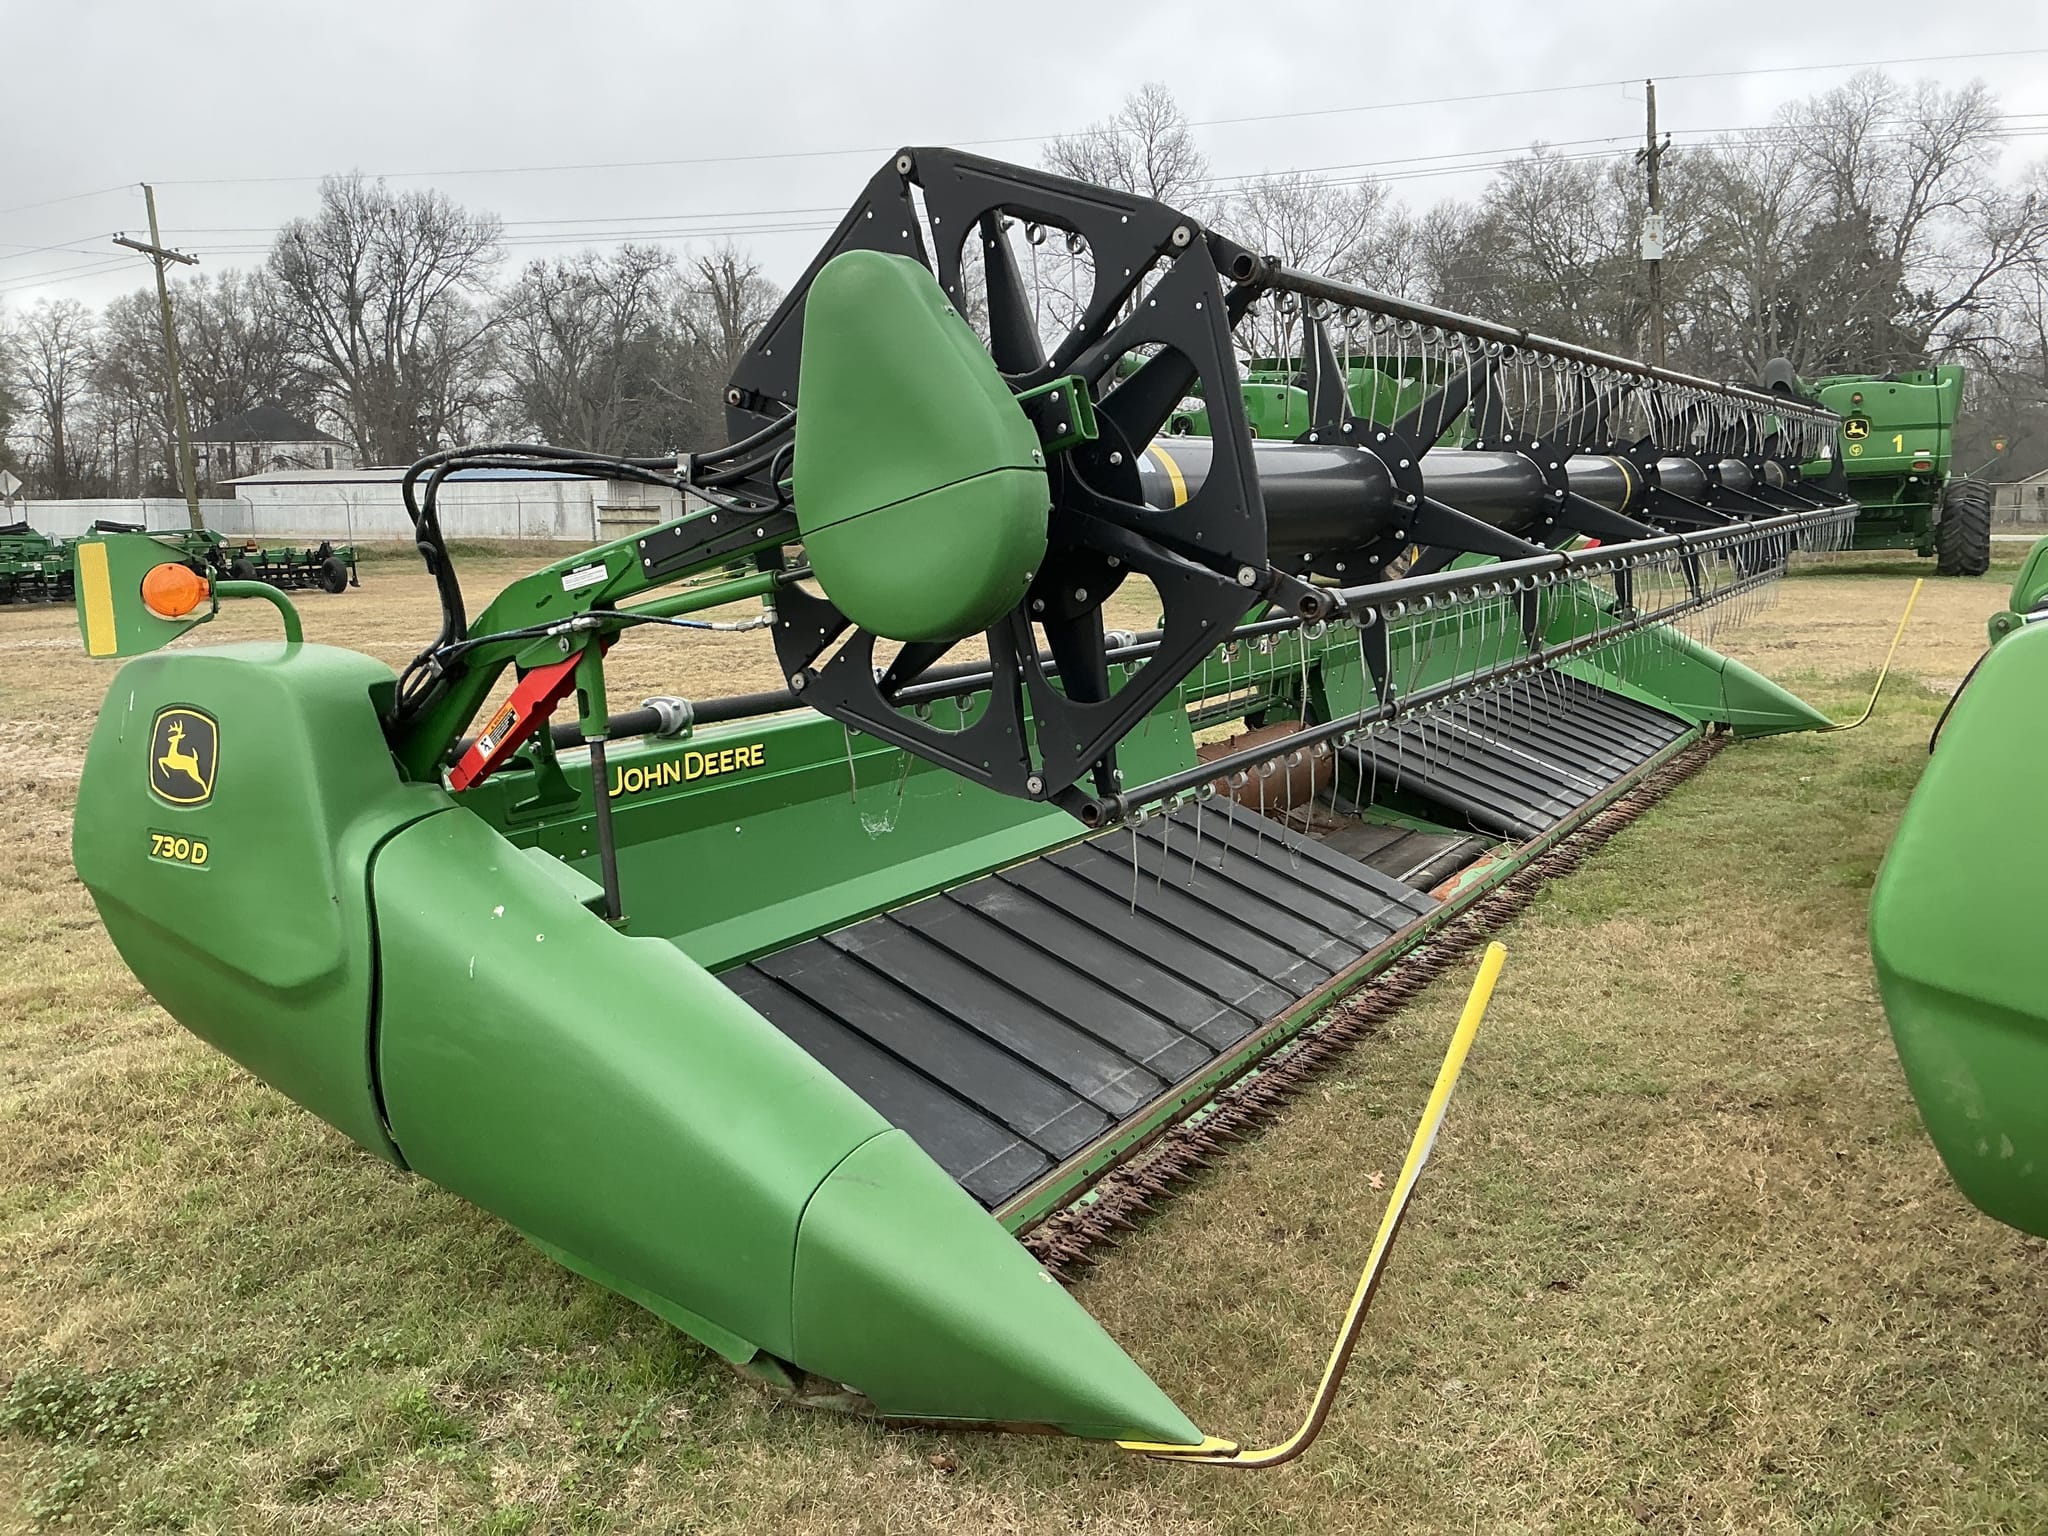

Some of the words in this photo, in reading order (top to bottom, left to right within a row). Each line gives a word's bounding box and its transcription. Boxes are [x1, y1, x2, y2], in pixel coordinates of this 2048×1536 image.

[1892, 434, 1903, 453] 1
[608, 760, 681, 797] JOHN
[684, 743, 765, 781] DEERE
